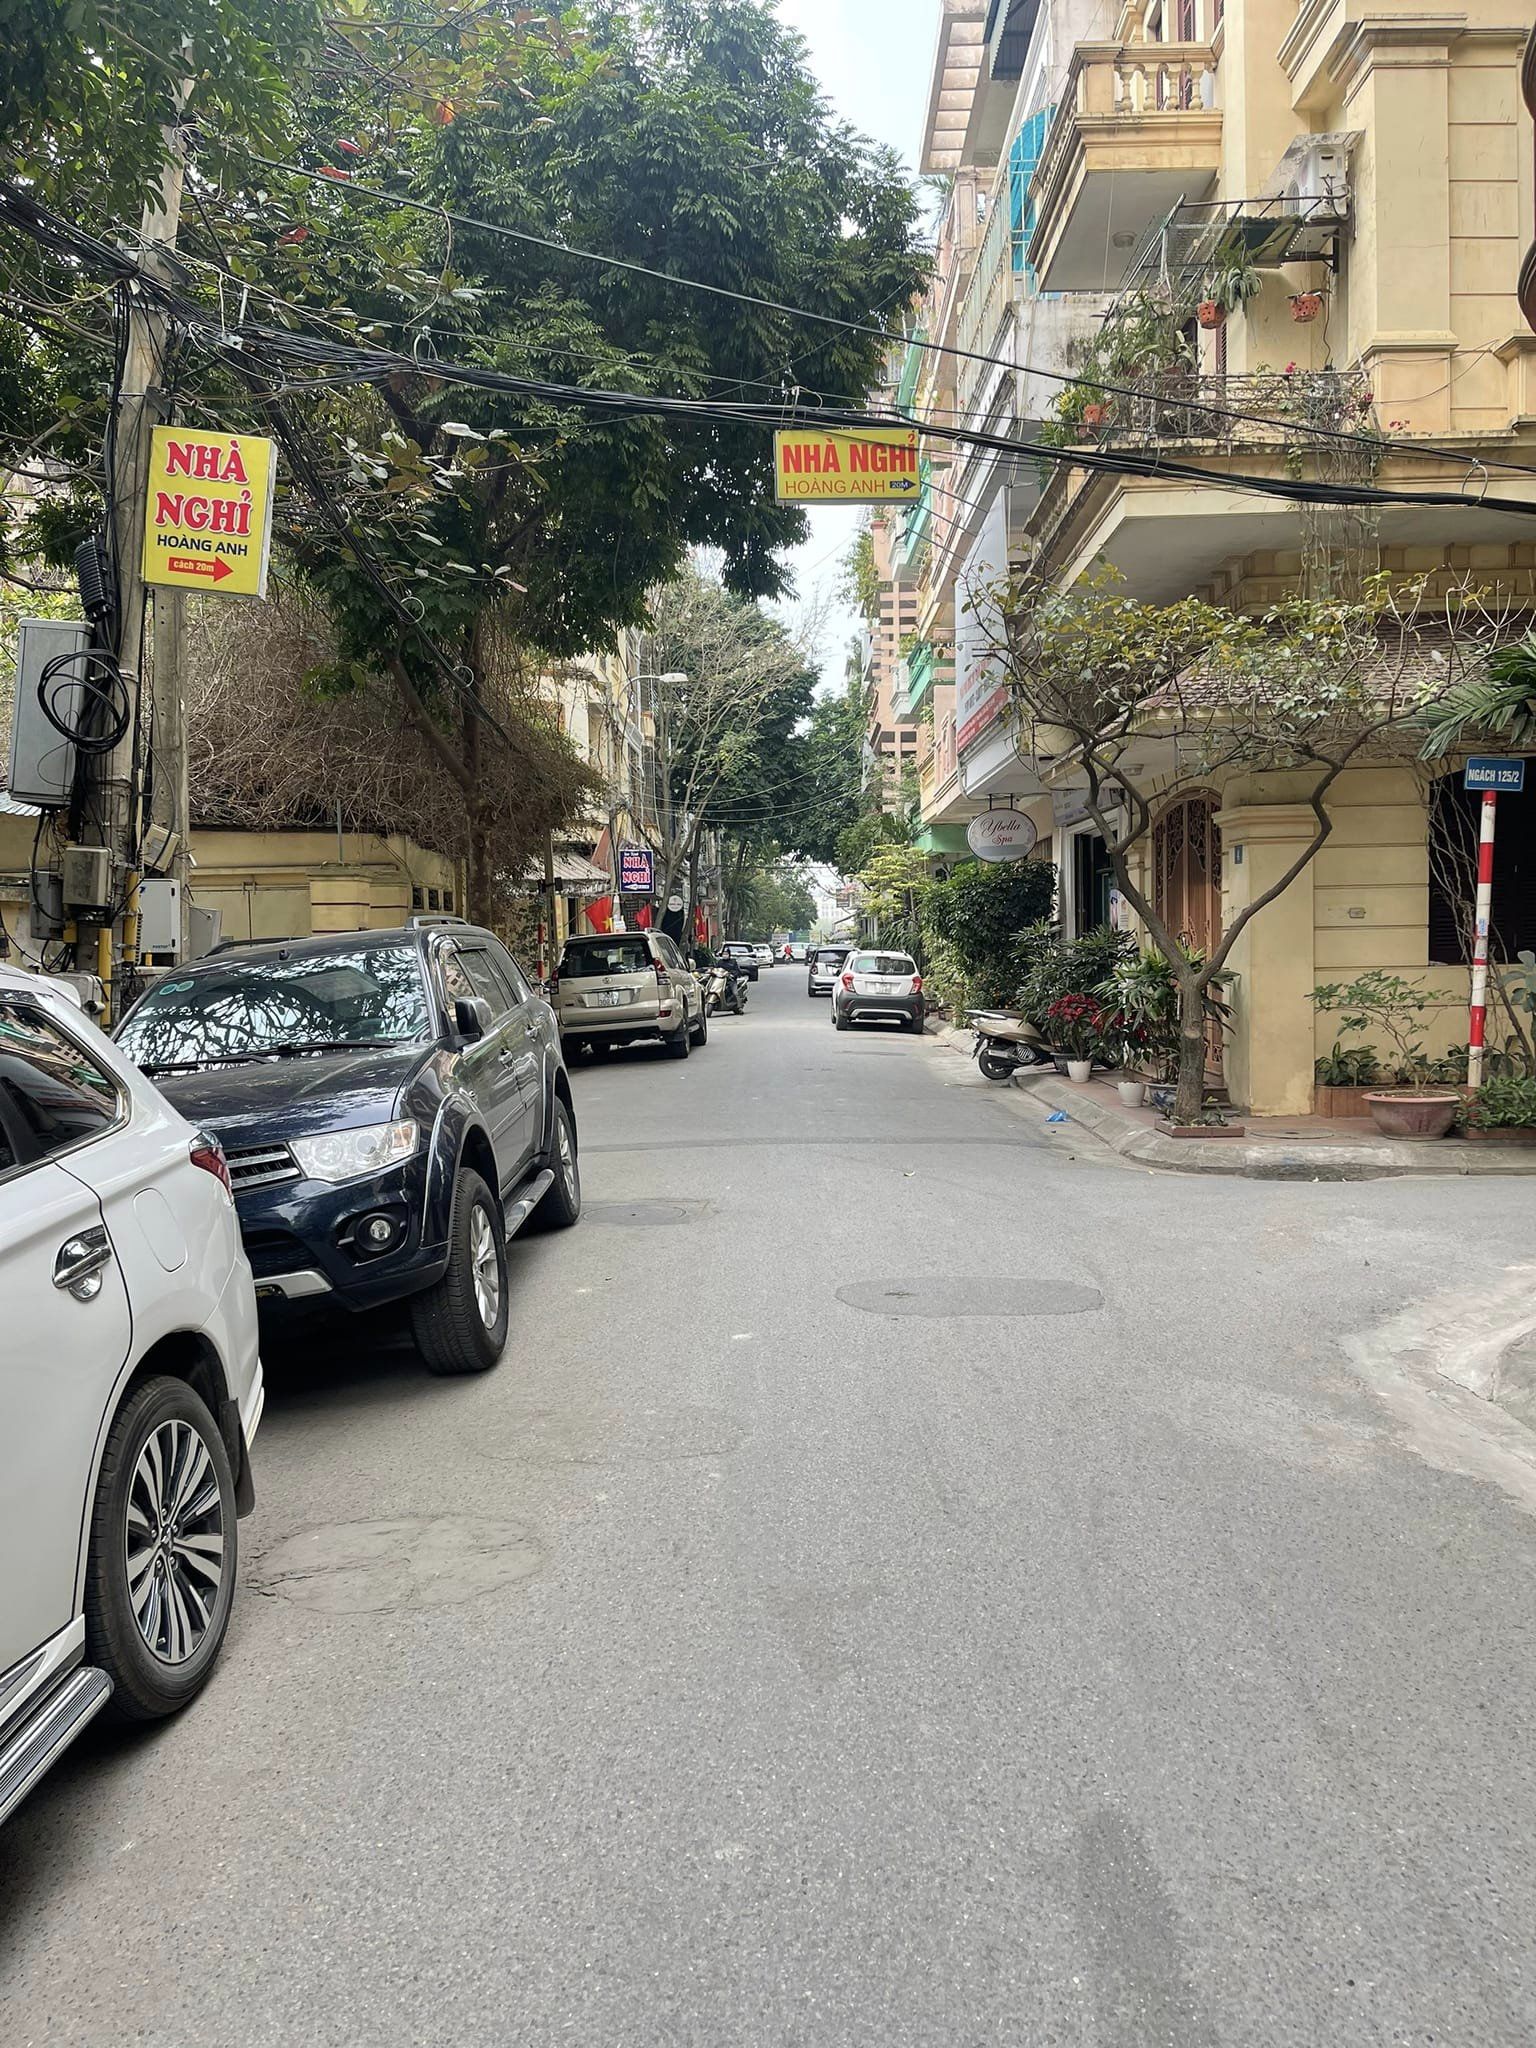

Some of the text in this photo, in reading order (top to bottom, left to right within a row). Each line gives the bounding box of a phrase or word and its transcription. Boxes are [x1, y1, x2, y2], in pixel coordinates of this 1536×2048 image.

[165, 438, 249, 484] NHÀ
[782, 433, 916, 473] NHÀ NGHỈ
[785, 478, 909, 494] HOÀNG ANH 20M
[155, 489, 253, 536] NGHỈ
[157, 534, 248, 556] HOÀNG ANH
[173, 559, 215, 572] cách 20m
[1468, 766, 1520, 783] NGÁCH 125/2
[992, 834, 1013, 846] Spa
[623, 853, 649, 868] NHÀ
